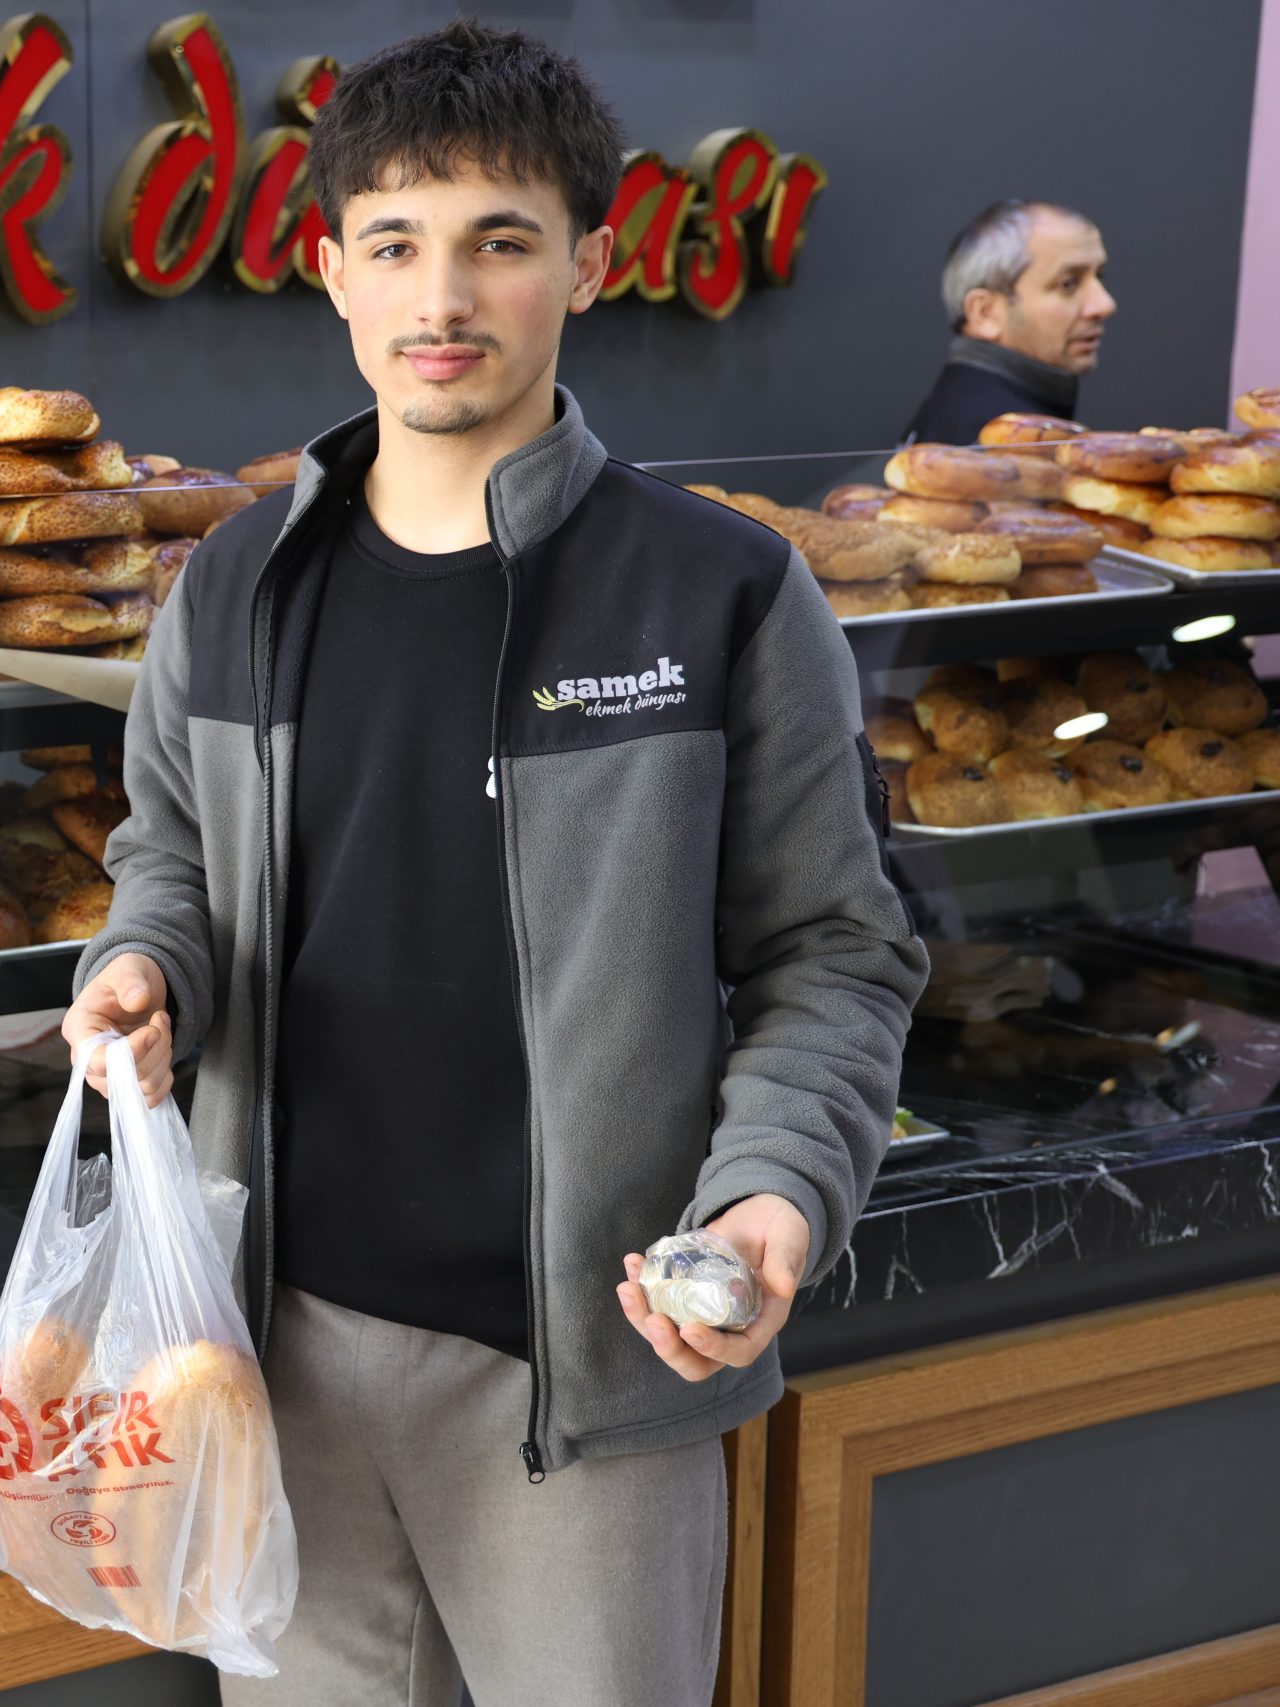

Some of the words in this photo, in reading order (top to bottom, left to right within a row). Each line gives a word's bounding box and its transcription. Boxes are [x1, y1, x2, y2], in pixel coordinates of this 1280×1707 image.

[104, 11, 829, 320] düası
[557, 656, 685, 701] samek
[586, 697, 631, 717] ekmek
[635, 692, 686, 711] dünyası
[66, 1485, 110, 1497] Doğaya
